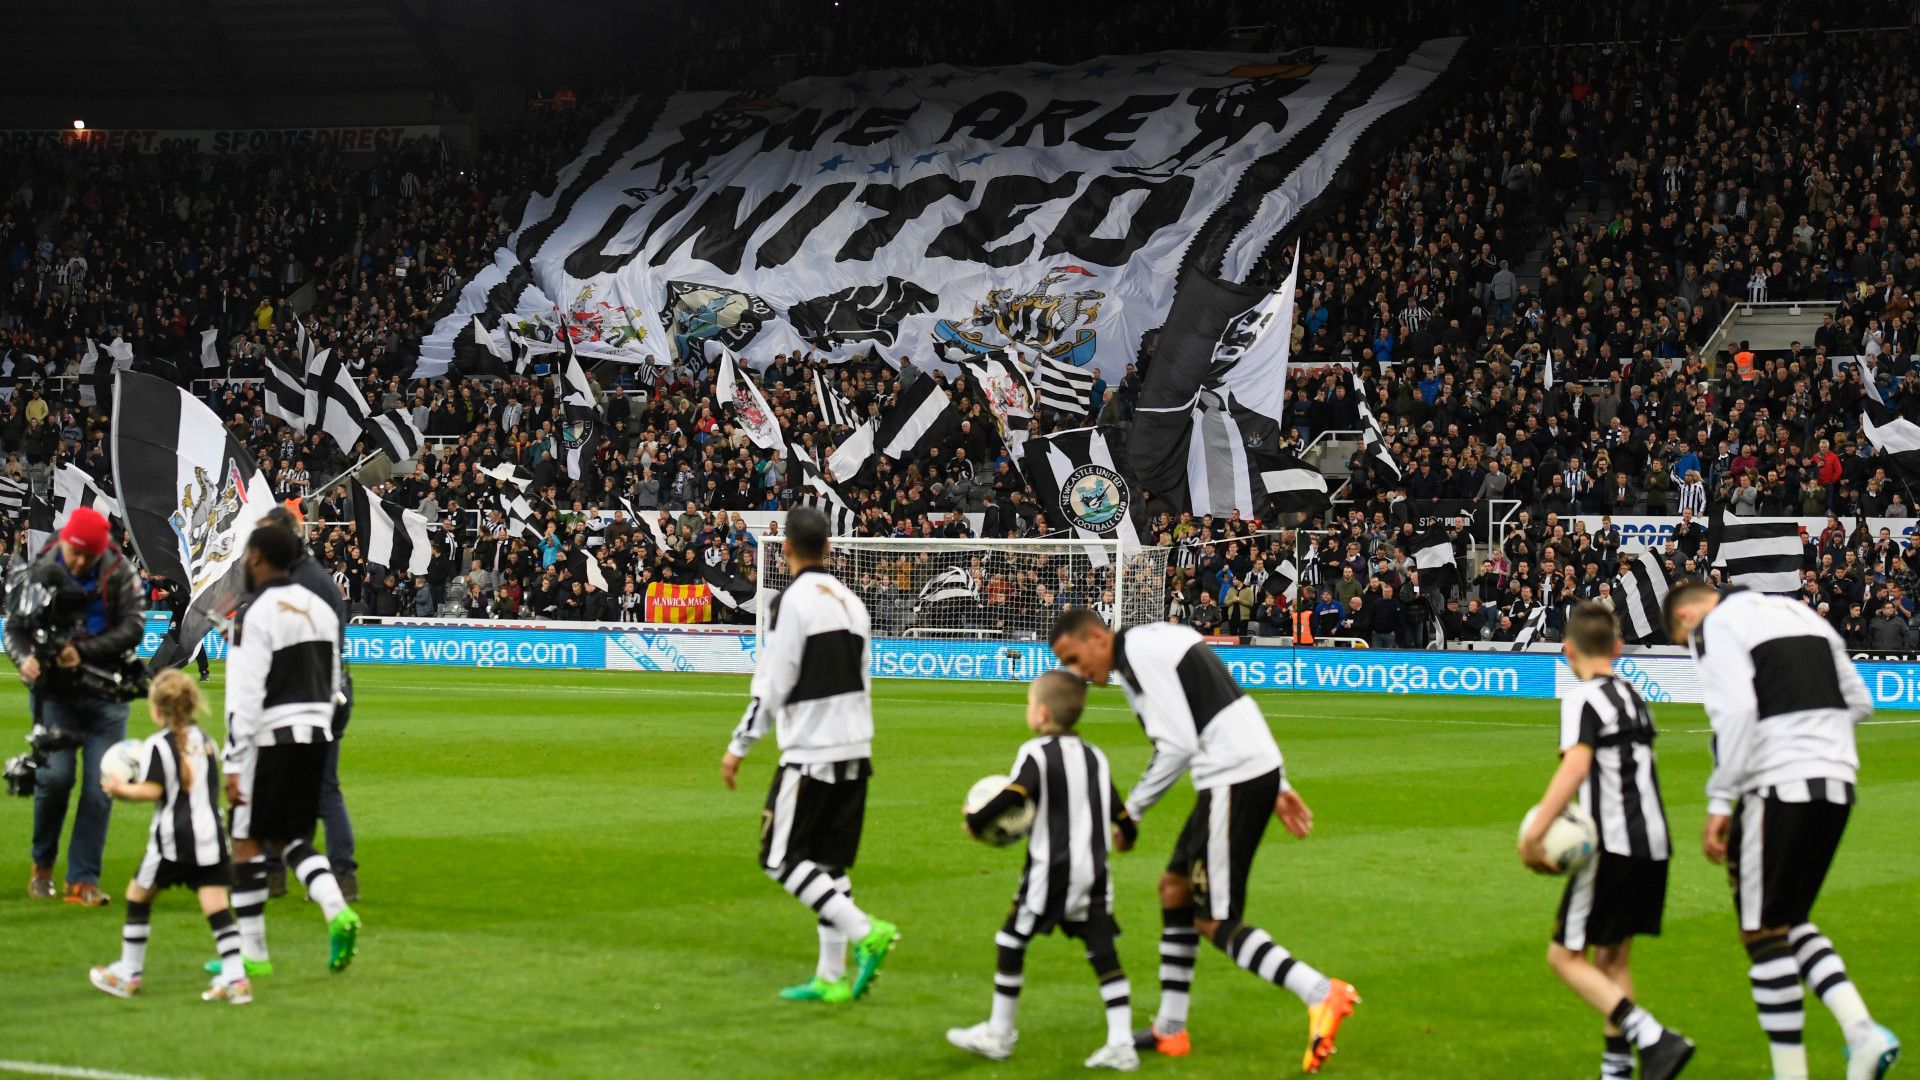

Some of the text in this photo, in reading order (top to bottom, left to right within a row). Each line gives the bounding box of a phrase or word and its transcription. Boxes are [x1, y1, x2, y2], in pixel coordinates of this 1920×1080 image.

[936, 91, 1181, 151] ARE
[564, 171, 1196, 279] UNITED
[1062, 467, 1123, 506] NEWCASTLE UNITED
[1073, 501, 1127, 531] FOOTBALL CLUB
[1445, 517, 1471, 527] PUA
[652, 596, 709, 607] ALNWICK MAGS
[389, 635, 416, 660] at
[420, 638, 578, 667] wonga.com
[868, 643, 988, 676] iscover
[1273, 658, 1303, 685] at
[1315, 663, 1519, 693] wonga.com
[1876, 670, 1920, 702] Di
